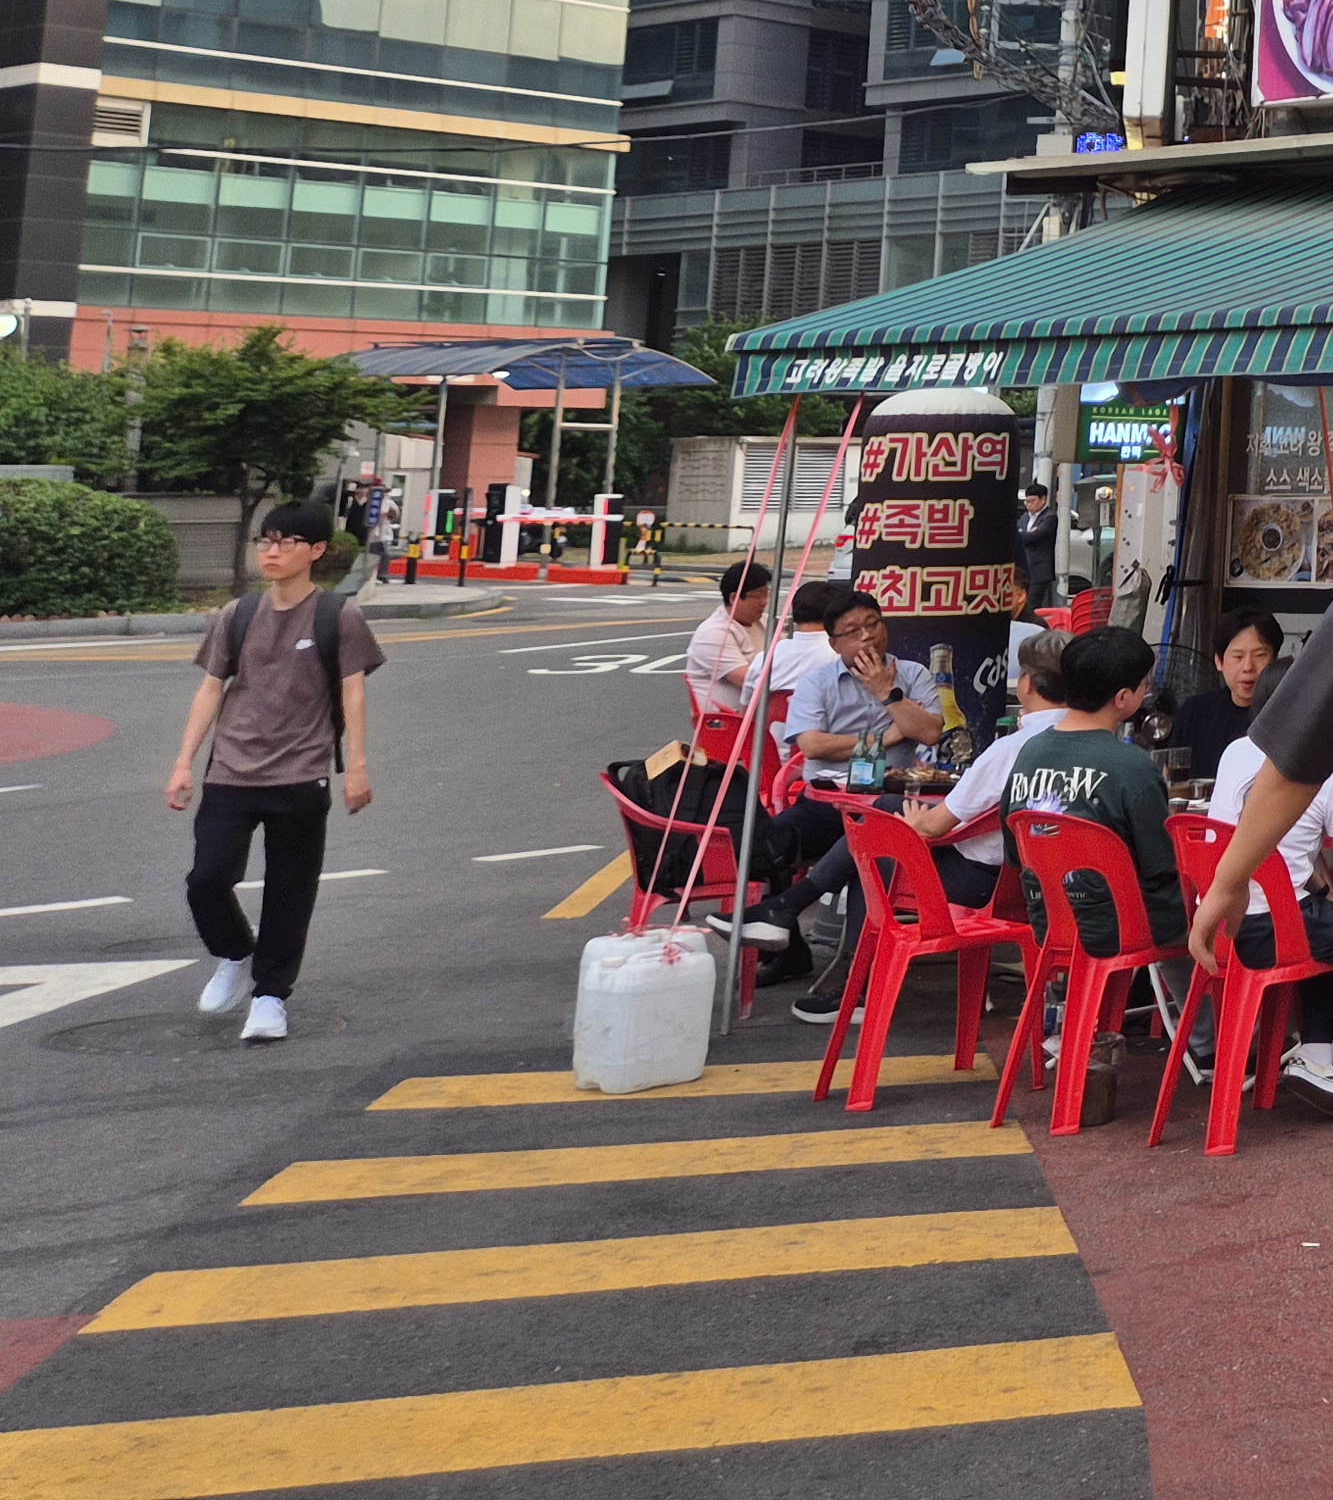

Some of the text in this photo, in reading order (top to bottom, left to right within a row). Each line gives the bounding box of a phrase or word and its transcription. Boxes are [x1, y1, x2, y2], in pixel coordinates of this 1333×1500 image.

[785, 350, 1004, 385] 고려왕족발 을지로골뱅이
[861, 432, 1010, 482] #가산역
[856, 499, 974, 549] #족발
